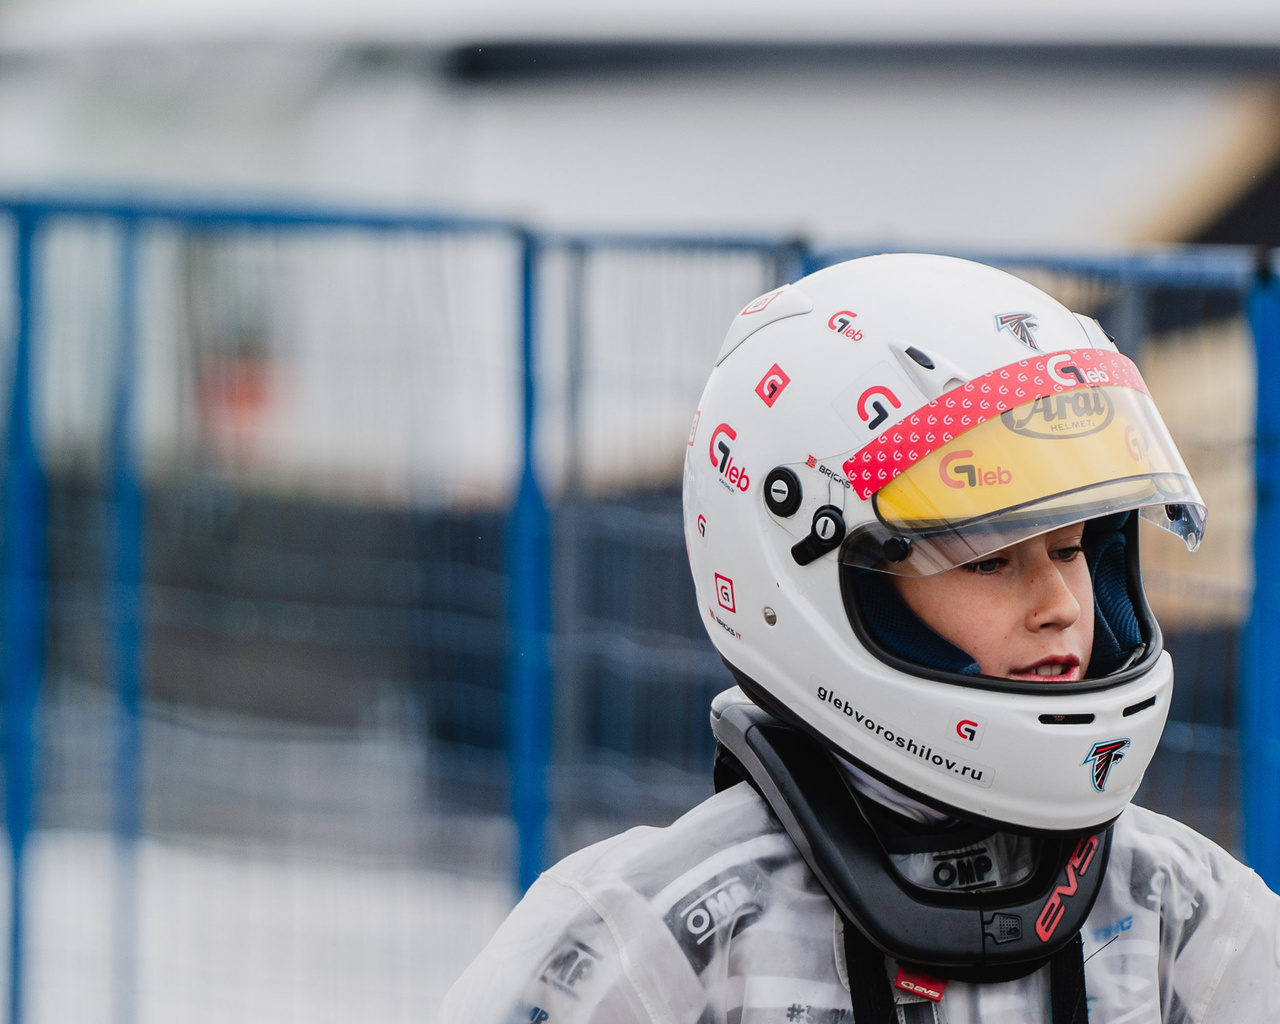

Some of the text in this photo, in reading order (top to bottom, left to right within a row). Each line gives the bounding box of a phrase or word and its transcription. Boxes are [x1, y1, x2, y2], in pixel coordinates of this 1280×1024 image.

[1015, 385, 1106, 429] Arai
[1050, 419, 1093, 432] HELMET
[817, 684, 983, 781] glebvoroshilov.ru
[933, 849, 995, 889] OMP
